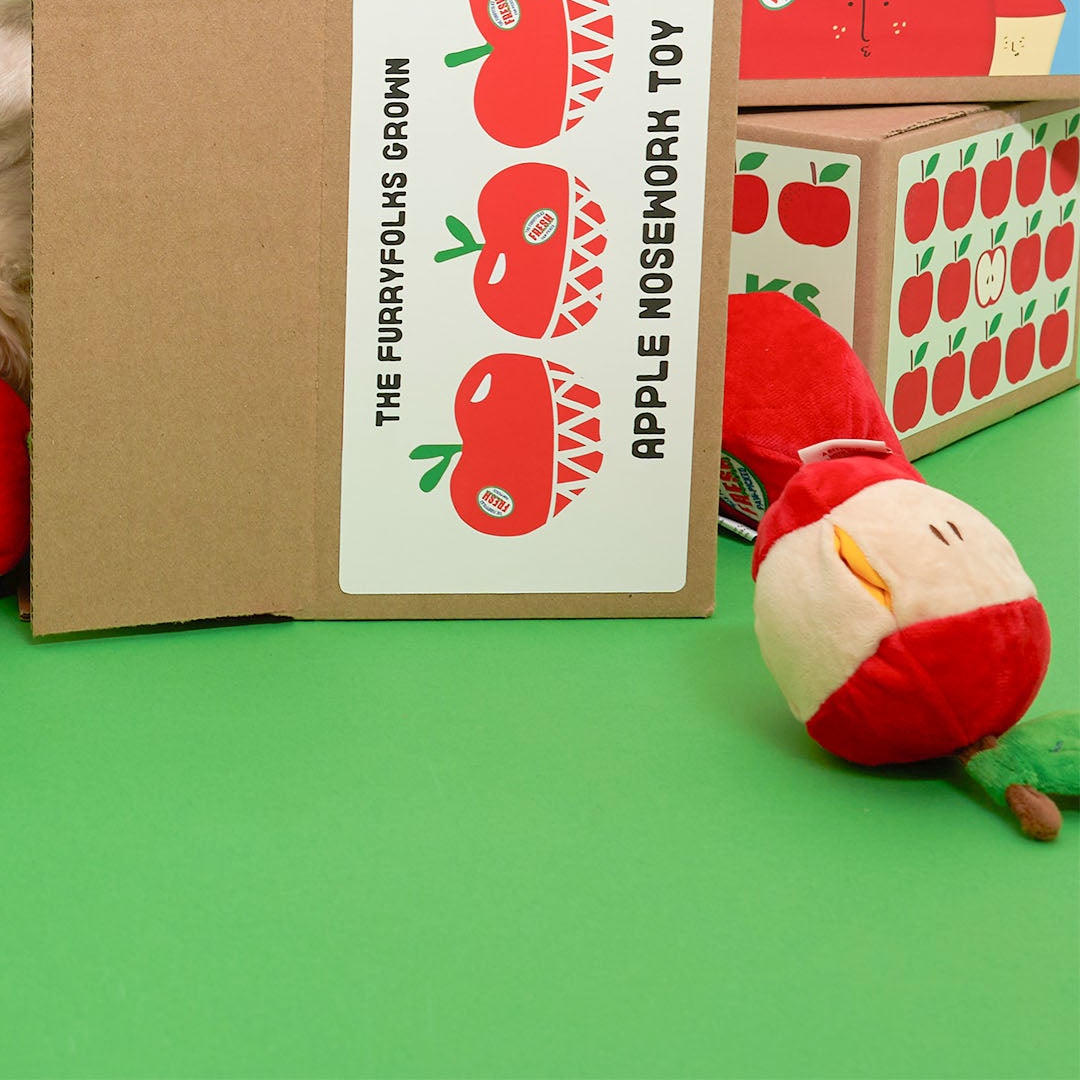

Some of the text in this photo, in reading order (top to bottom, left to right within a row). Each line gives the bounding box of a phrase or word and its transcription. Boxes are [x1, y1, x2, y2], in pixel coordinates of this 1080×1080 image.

[374, 57, 411, 427] THE FURRYFOLKS GROWN
[528, 213, 554, 241] FRESH
[631, 19, 684, 460] APPLE NOSEWORK TOY
[482, 490, 510, 513] FRESH
